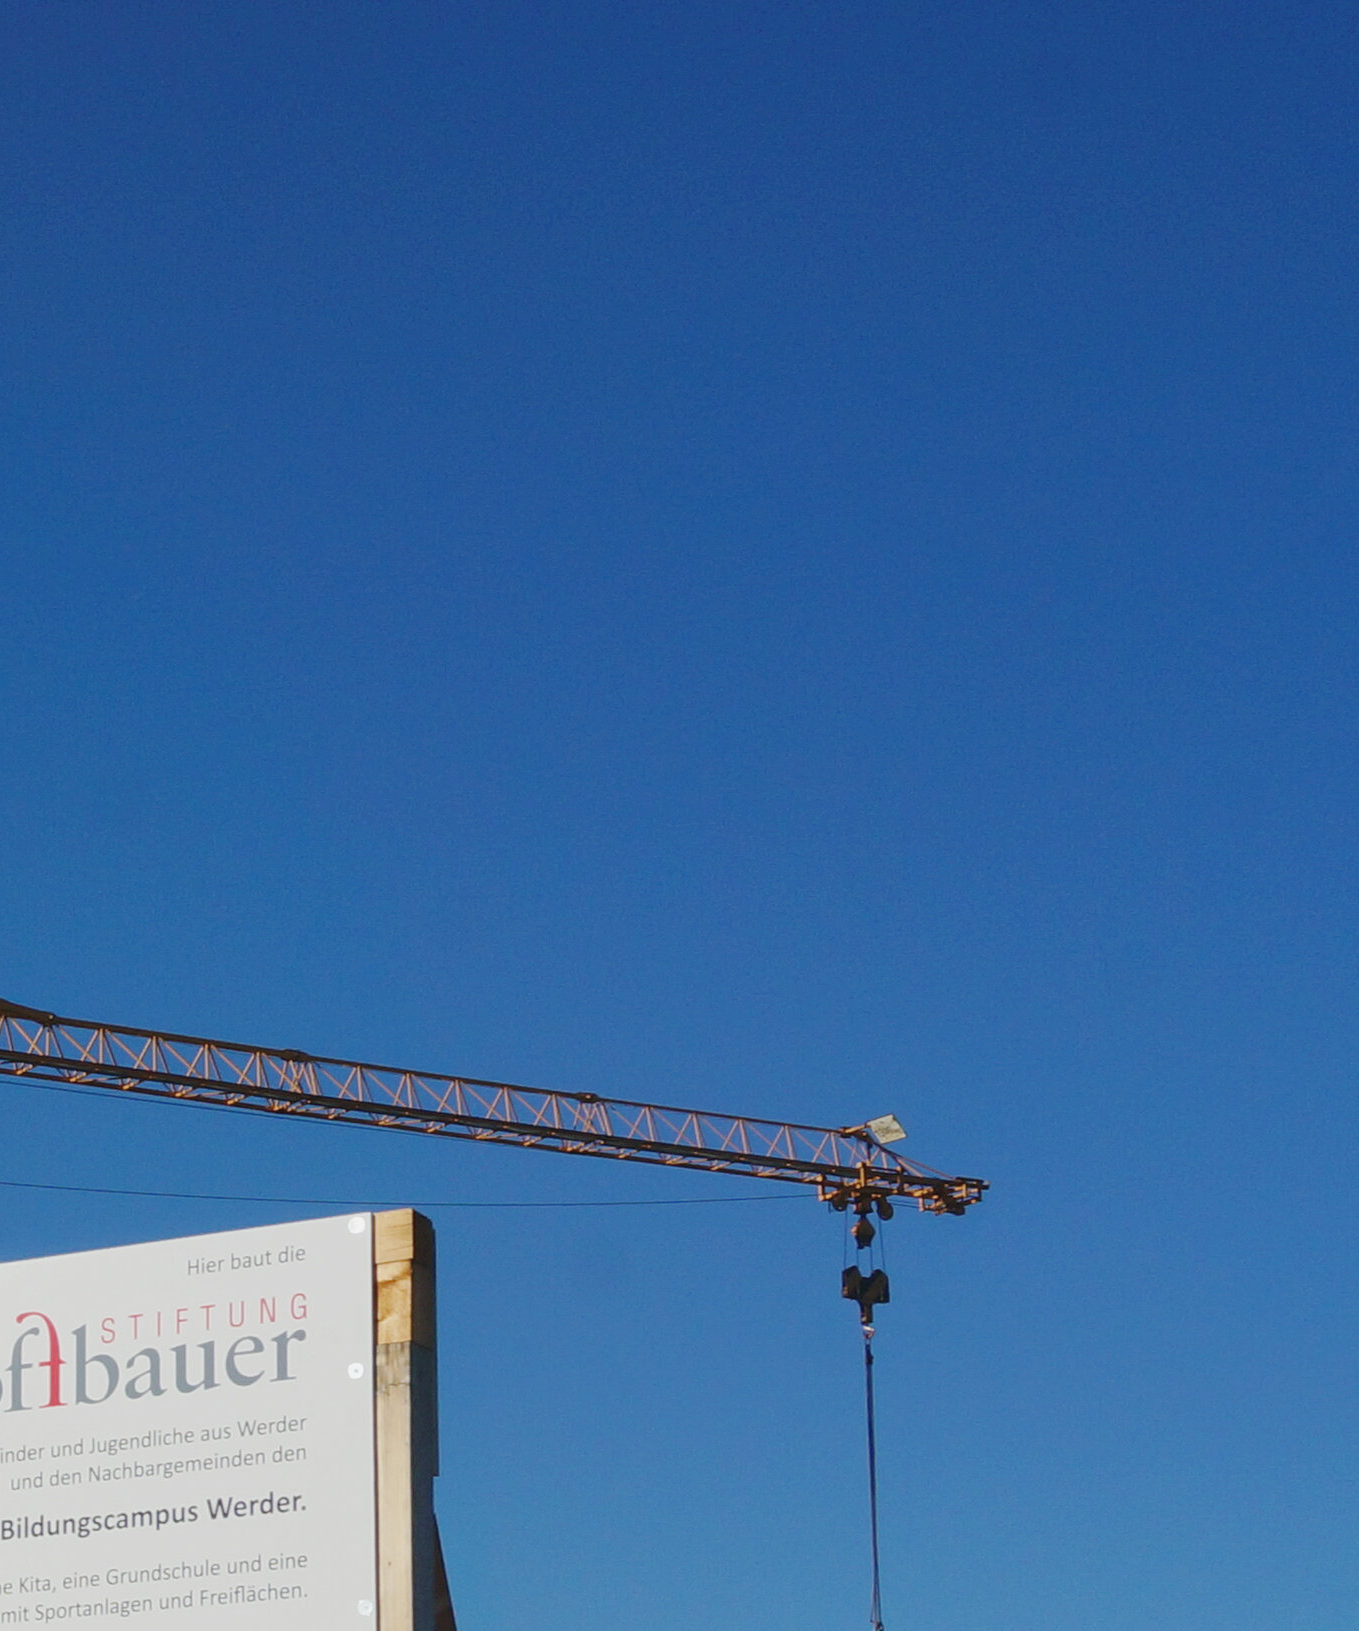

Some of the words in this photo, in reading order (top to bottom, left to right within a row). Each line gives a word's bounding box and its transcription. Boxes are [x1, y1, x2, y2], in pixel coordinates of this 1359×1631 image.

[188, 1258, 225, 1276] Hier
[231, 1251, 272, 1270] baut
[278, 1245, 306, 1263] die
[101, 1293, 307, 1344] STIFTUNG
[51, 1438, 83, 1458] und
[89, 1427, 194, 1456] Jugendliche
[201, 1426, 231, 1442] aus
[237, 1415, 307, 1437] Werder
[11, 1471, 43, 1491] und
[49, 1469, 82, 1487] den
[89, 1449, 265, 1482] Nachbargemeinden
[272, 1445, 306, 1463] den
[1, 1506, 198, 1540] Bildungscampus
[207, 1491, 306, 1520] Werder.
[19, 1576, 56, 1593] Kita,
[63, 1572, 100, 1589] eine
[106, 1559, 220, 1585] Grundschule
[227, 1554, 261, 1574] und
[268, 1553, 308, 1571] eine
[1, 1606, 29, 1623] mit
[35, 1597, 152, 1624] Sportanlagen
[159, 1590, 193, 1610] und
[200, 1583, 308, 1606] Freiflächen.
